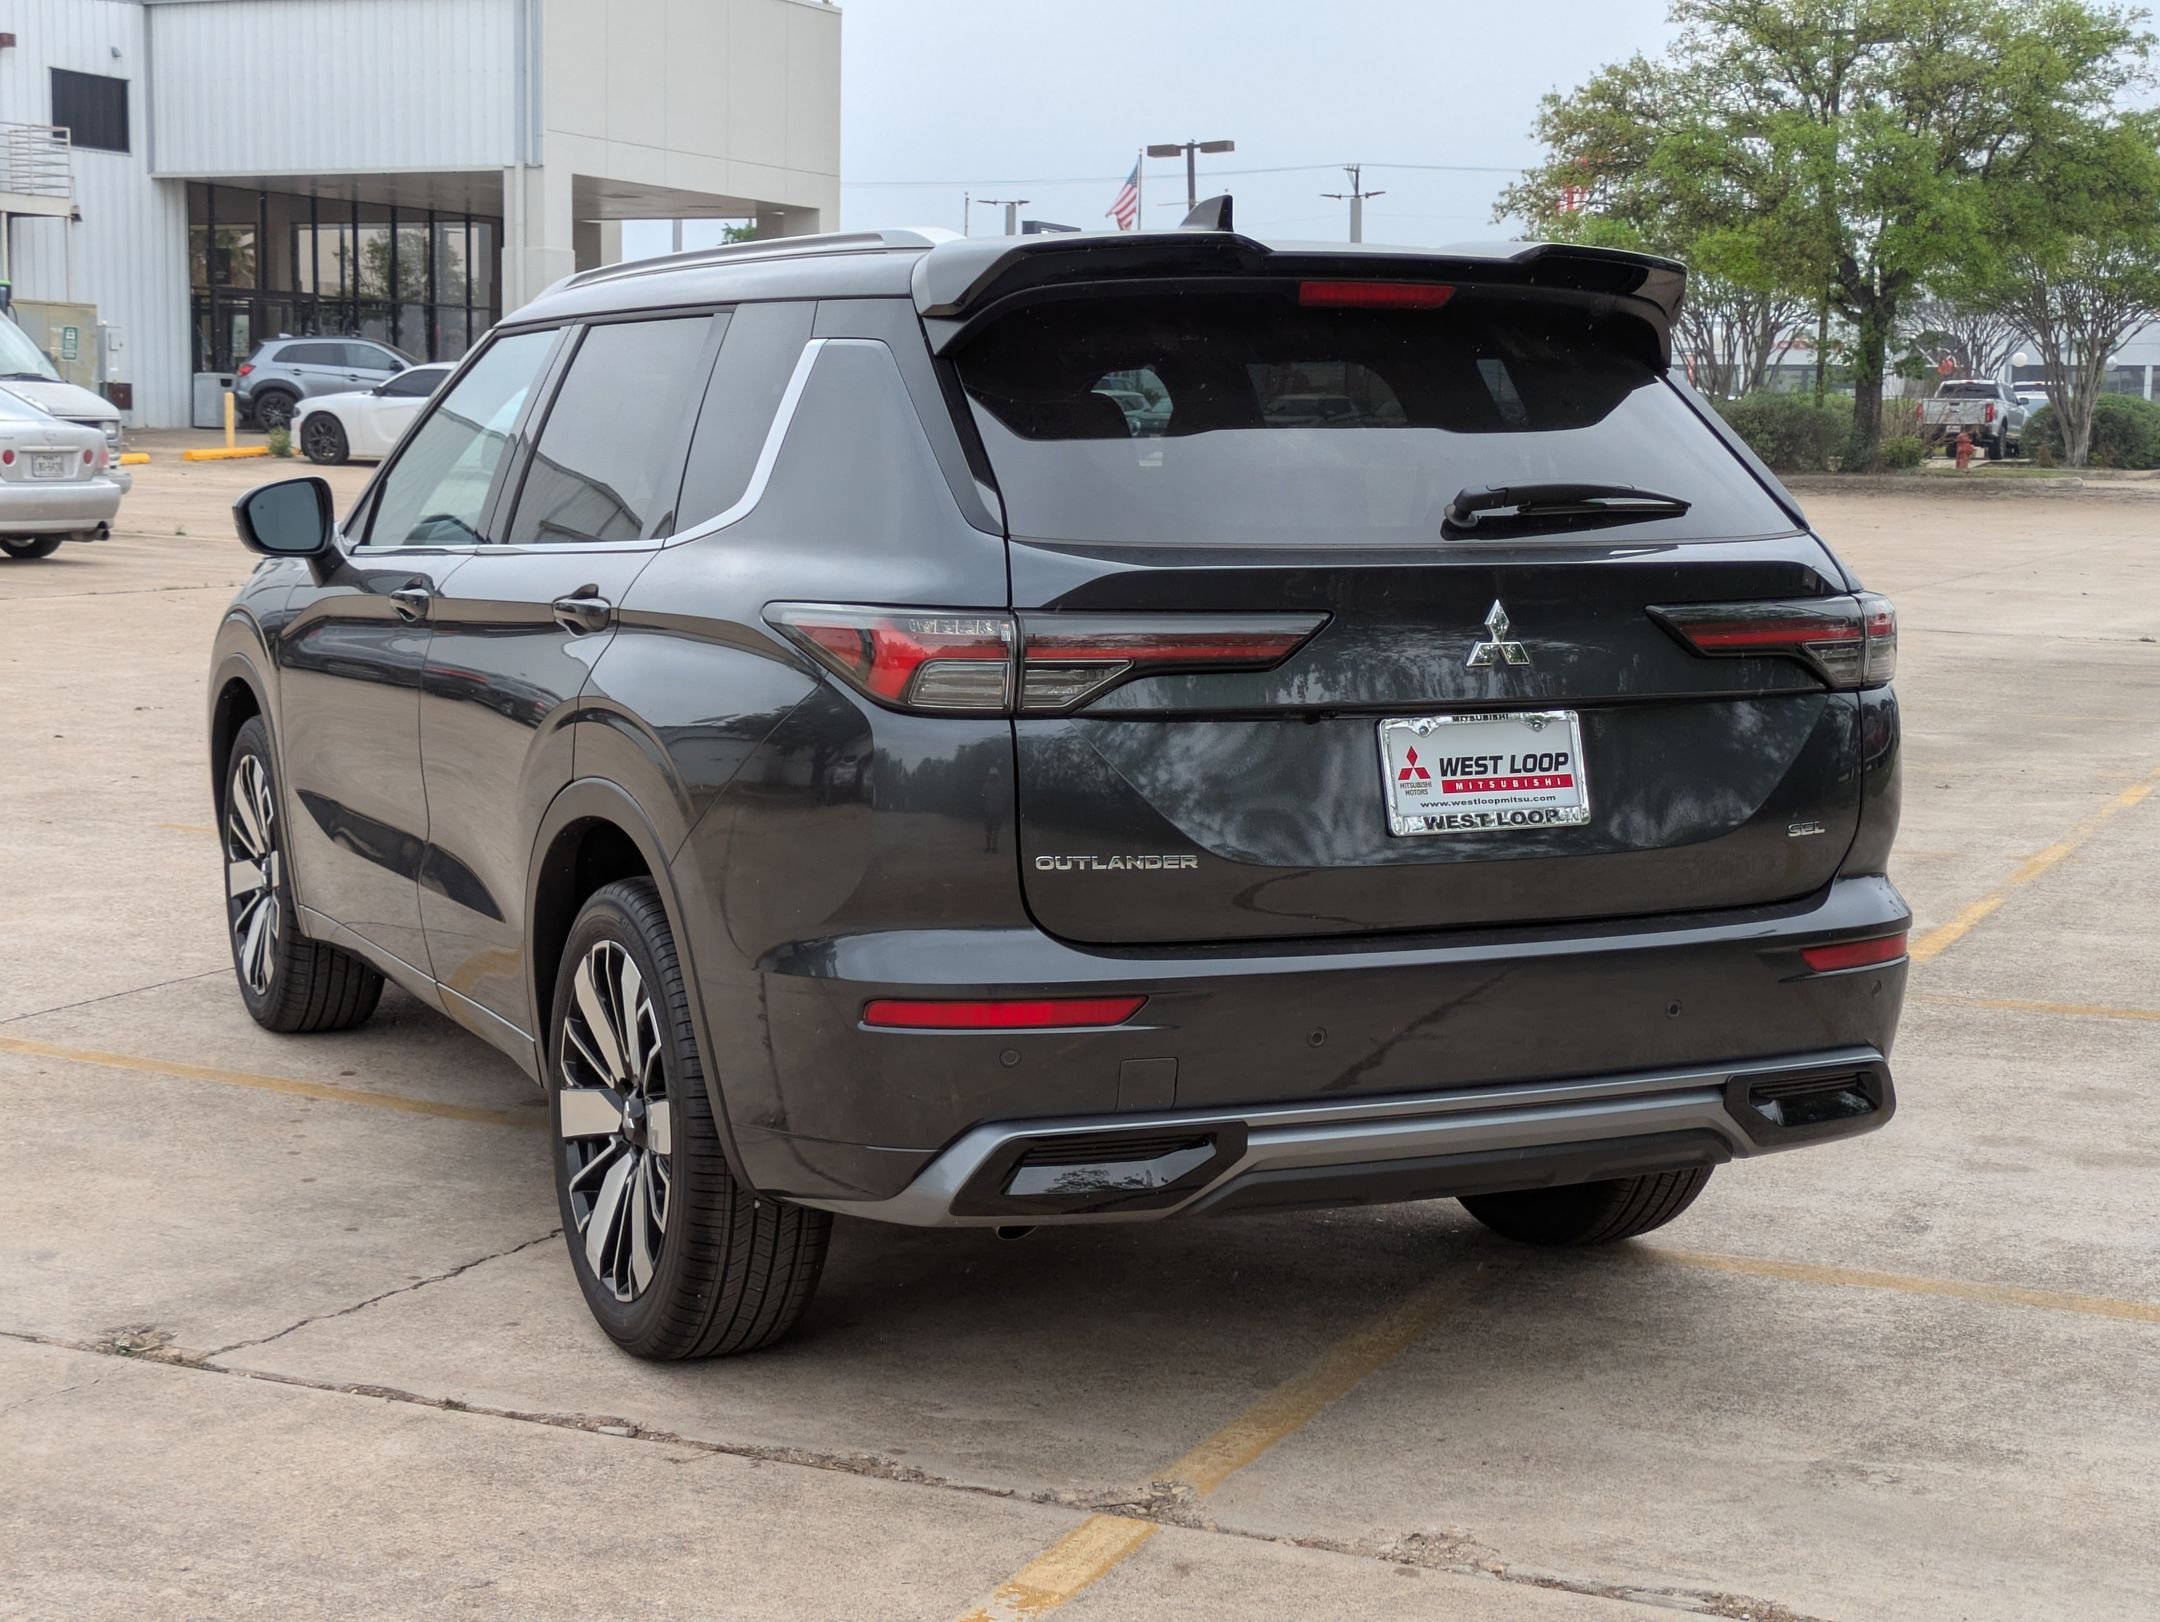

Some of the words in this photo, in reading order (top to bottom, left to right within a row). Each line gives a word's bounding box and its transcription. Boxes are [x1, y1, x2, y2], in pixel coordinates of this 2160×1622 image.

[1452, 713, 1509, 722] MITSUBISHI
[1439, 755, 1503, 777] WEST
[1509, 752, 1569, 774] LOOP
[1400, 781, 1432, 789] MITSUBISHI
[1455, 777, 1561, 791] MITSUBISHI
[1420, 795, 1556, 808] www.westloopmitsu.com
[1424, 813, 1487, 830] WEST
[1498, 809, 1559, 826] LOOP
[1788, 821, 1825, 837] SEL
[1035, 855, 1198, 871] OUTLANDER
